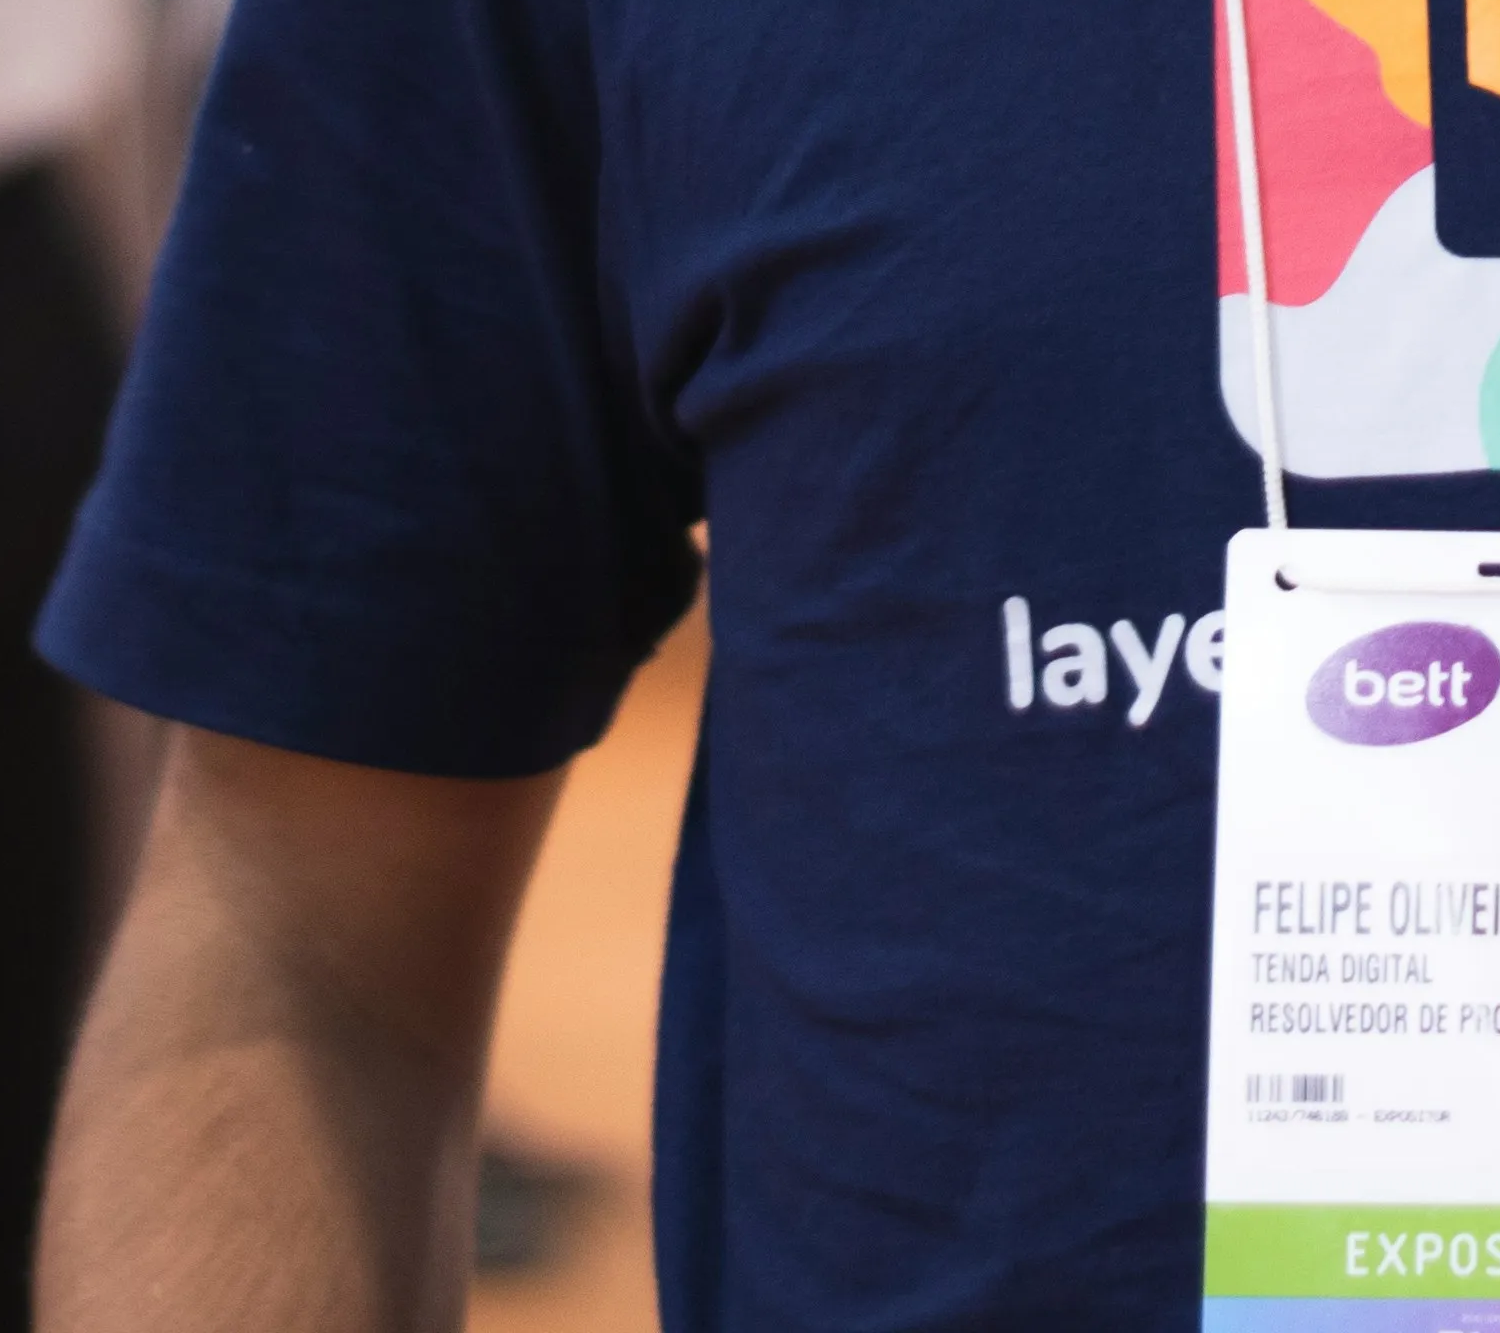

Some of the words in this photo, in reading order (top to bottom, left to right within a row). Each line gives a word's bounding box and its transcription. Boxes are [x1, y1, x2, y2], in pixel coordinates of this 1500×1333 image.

[1002, 595, 1225, 727] laye
[1343, 659, 1472, 708] bett
[1253, 881, 1373, 935] FELIPE
[1251, 952, 1331, 984] TENDA
[1341, 952, 1434, 984] DIGITAL
[1250, 1001, 1409, 1034] RESOLVEDOR
[1419, 1003, 1448, 1034] DE
